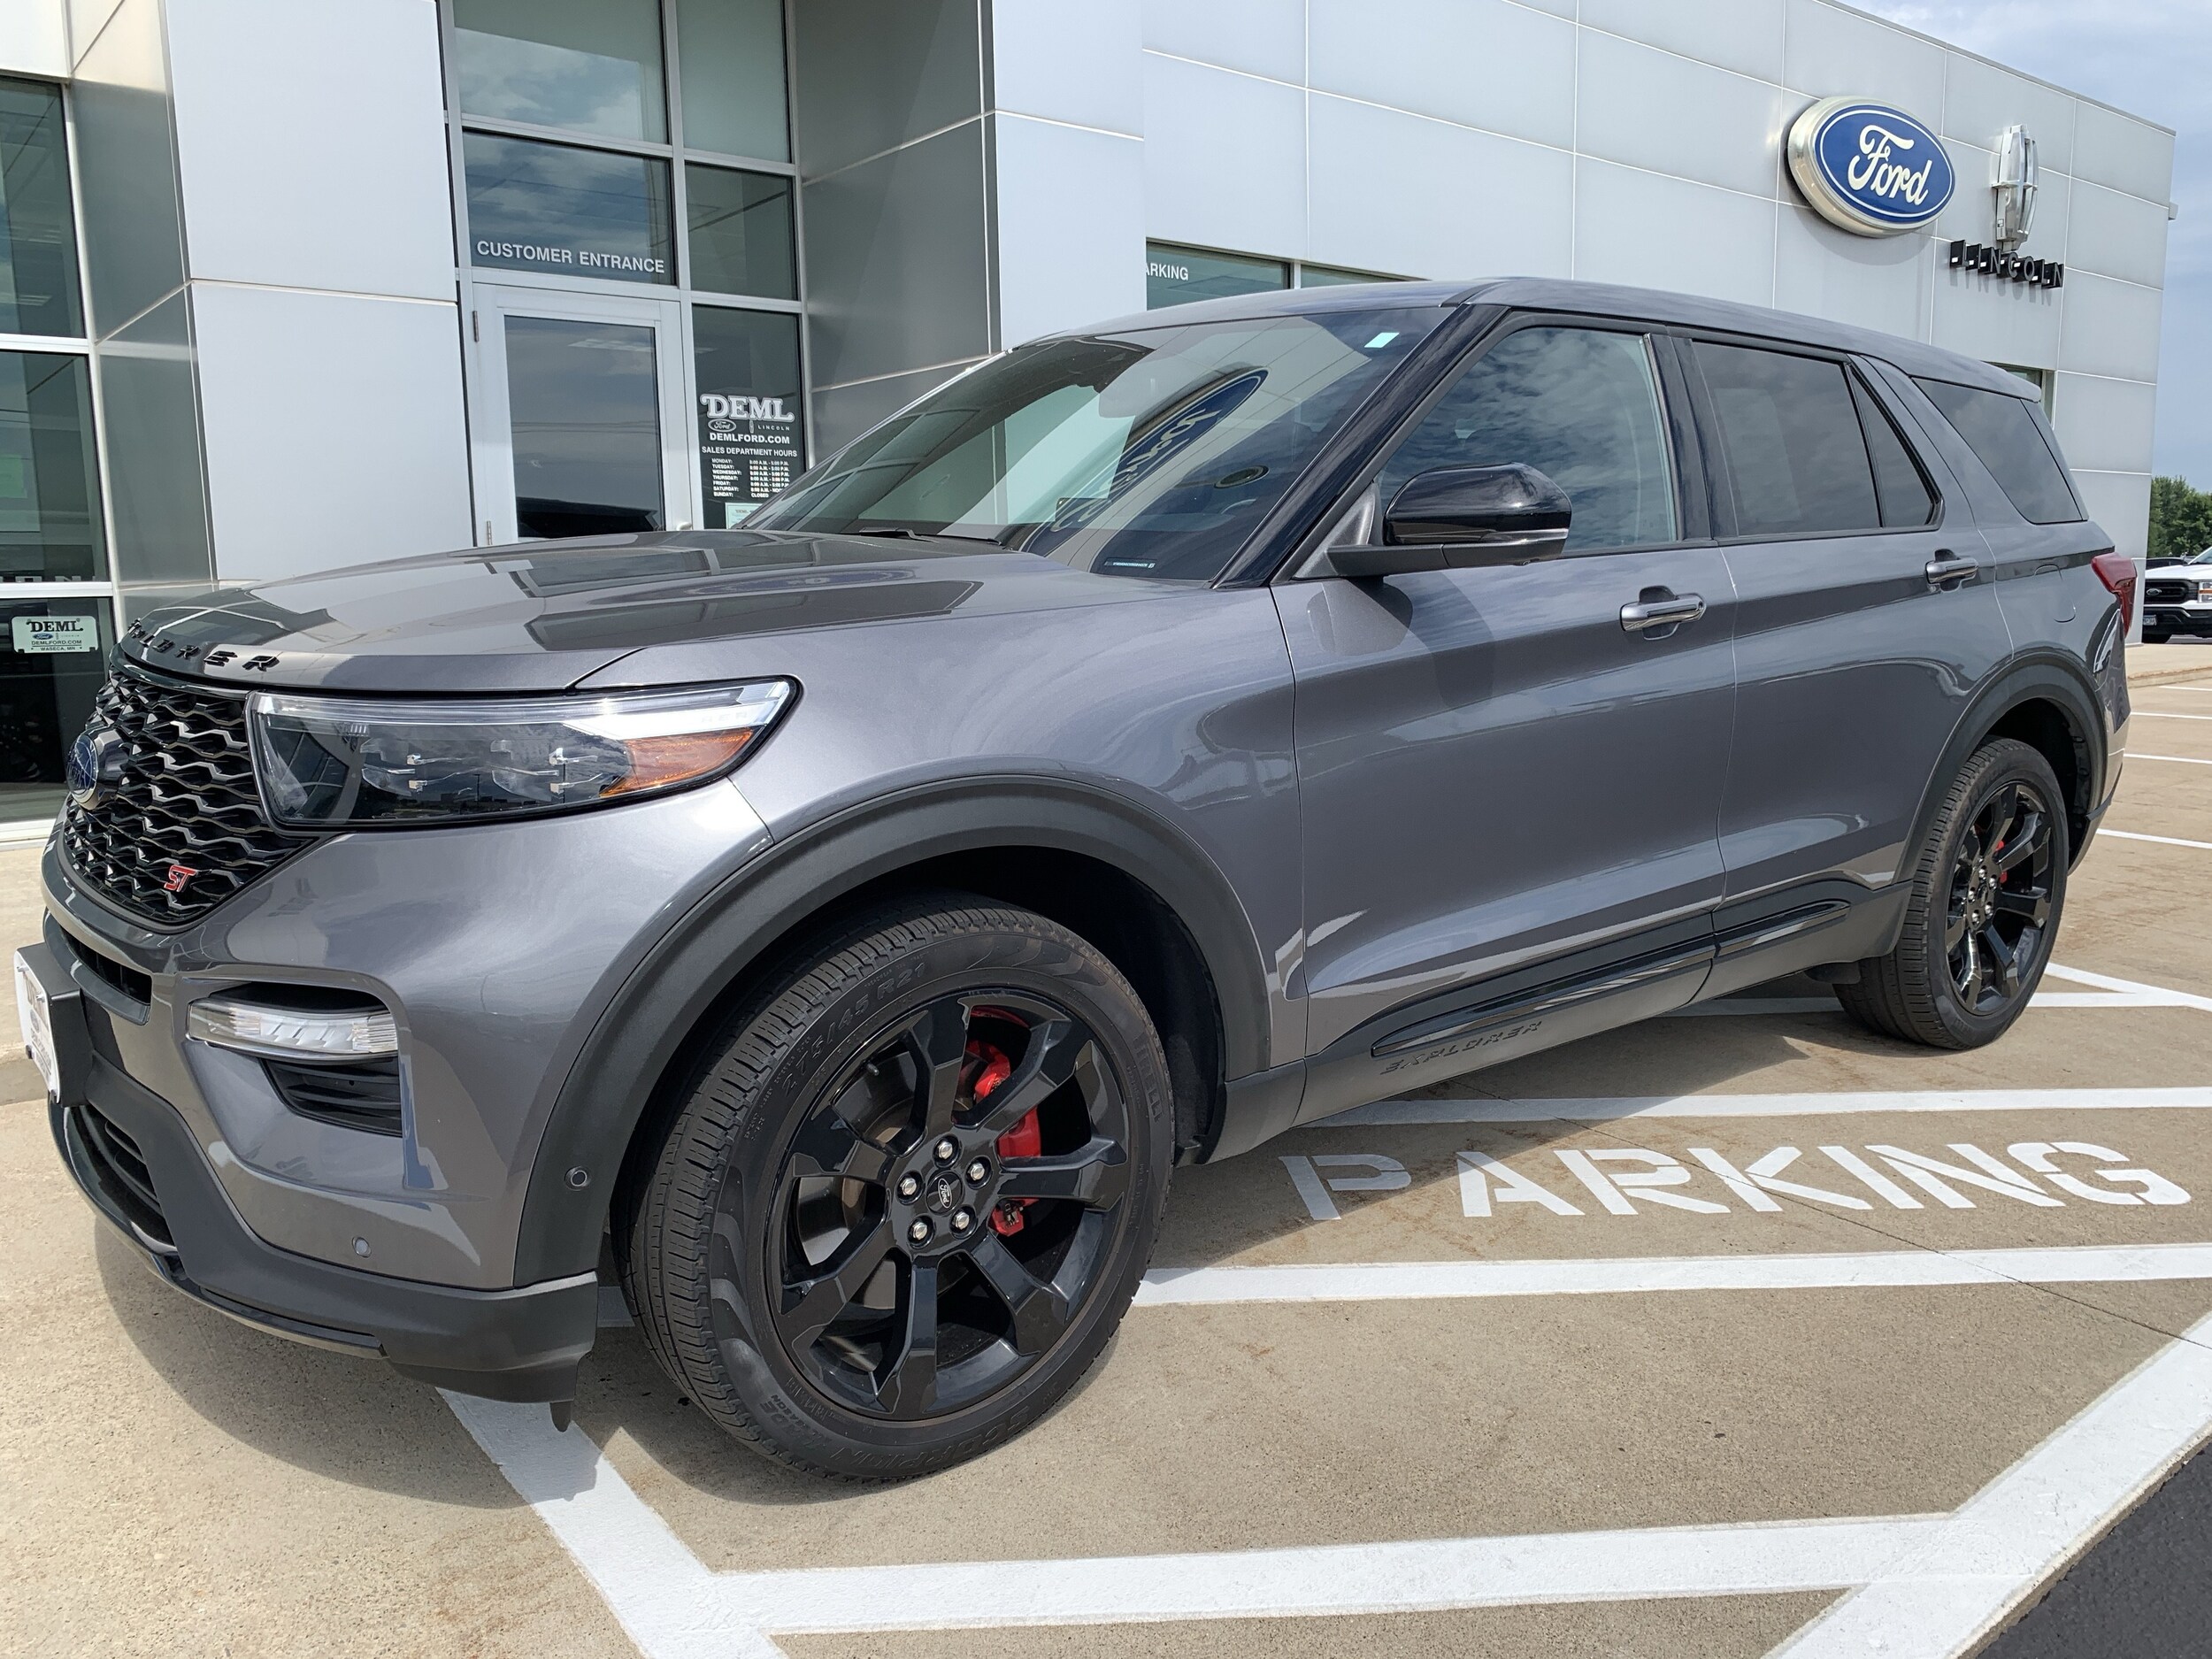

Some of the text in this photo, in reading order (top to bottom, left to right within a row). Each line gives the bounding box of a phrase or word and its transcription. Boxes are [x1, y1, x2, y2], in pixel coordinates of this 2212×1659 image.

[1847, 124, 1932, 206] Ford
[477, 240, 664, 273] CUSTOMER ENTRANCE
[1950, 240, 2064, 288] LINCOLN
[700, 394, 795, 422] DEML
[709, 432, 790, 444] DEMLFORD.COM
[726, 447, 772, 456] DEPARTMENT
[26, 620, 84, 633] DEML
[164, 864, 197, 892] ST
[1380, 1020, 1542, 1075] EXPLORER
[1279, 1141, 2192, 1221] PARKING
